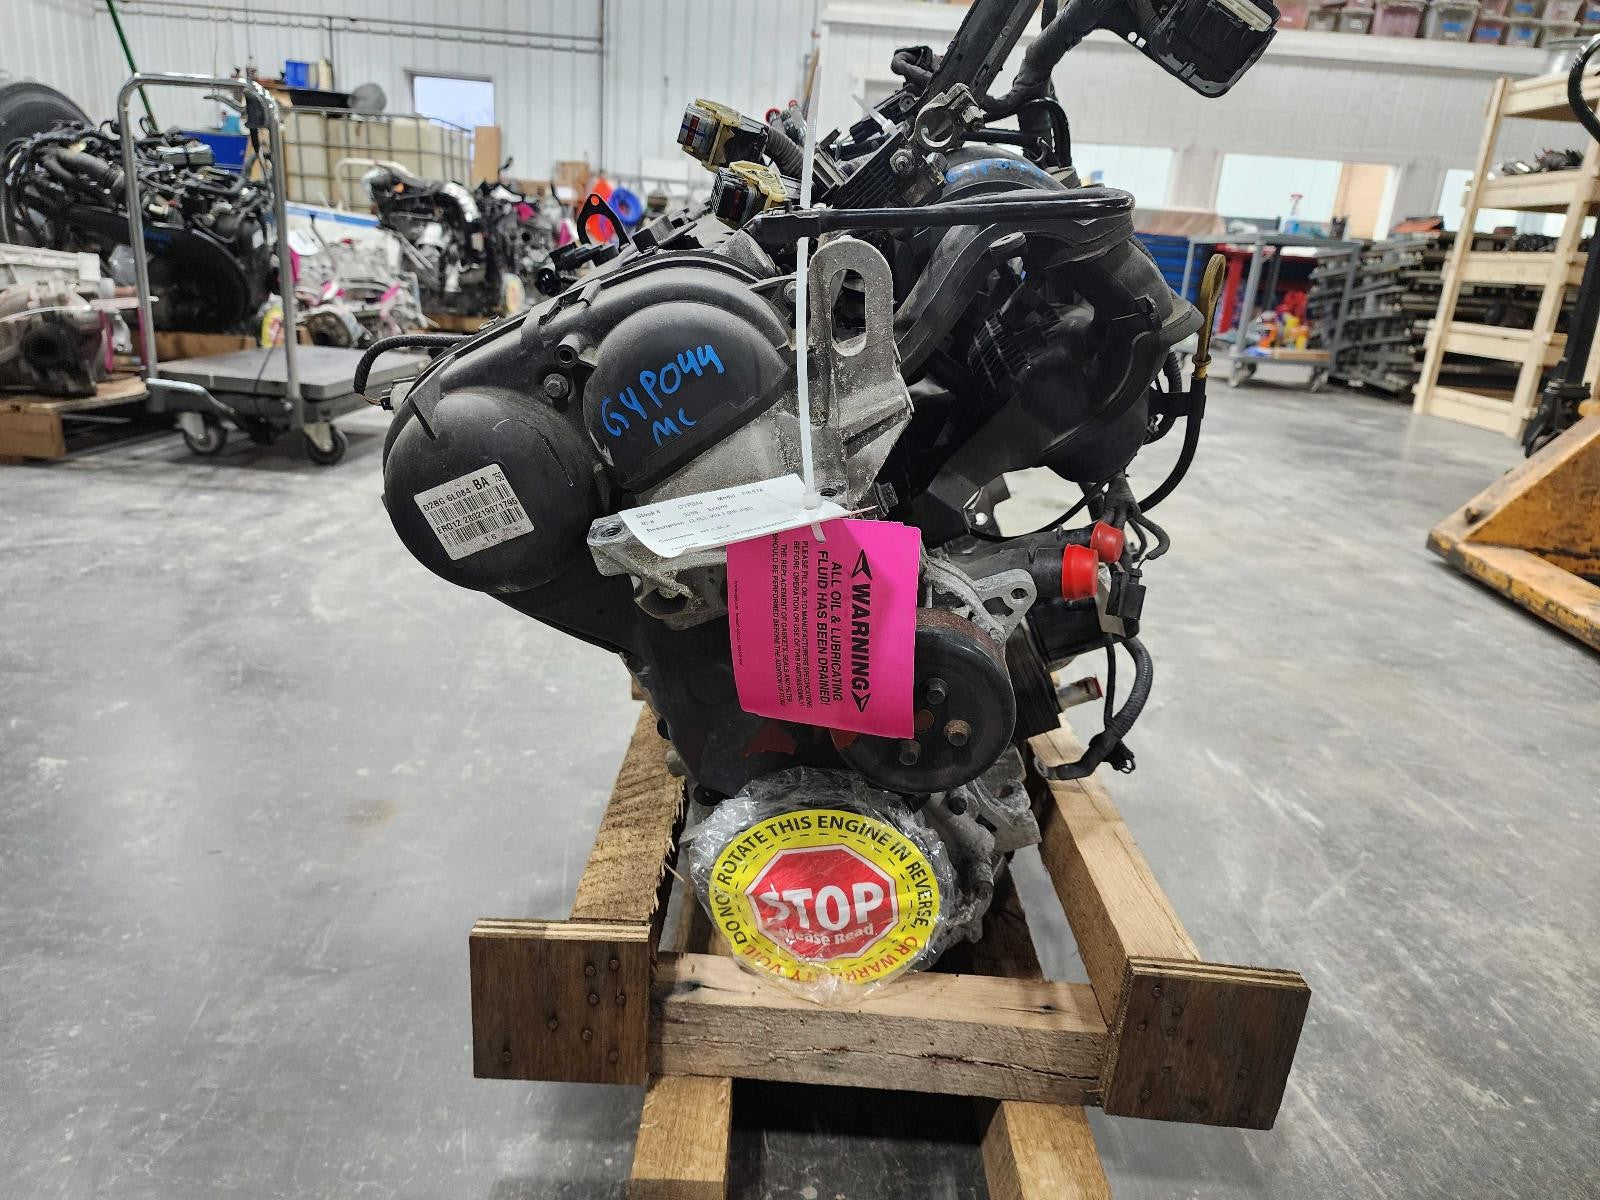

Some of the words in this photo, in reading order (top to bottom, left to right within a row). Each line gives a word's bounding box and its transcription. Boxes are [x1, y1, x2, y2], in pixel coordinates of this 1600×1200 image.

[601, 344, 725, 437] GYP044
[651, 408, 697, 448] MC
[422, 497, 446, 512] D2BG
[446, 487, 472, 502] 6L084
[473, 476, 490, 491] BA
[772, 565, 779, 575] BE
[818, 551, 829, 589] FLUID
[831, 562, 842, 587] ALL
[802, 601, 808, 609] TO
[817, 593, 828, 619] HAS
[831, 591, 842, 611] OIL
[781, 612, 788, 622] OF
[793, 613, 799, 623] OR
[831, 616, 841, 624] &
[794, 639, 800, 648] OF
[817, 623, 828, 655] BEEN
[852, 584, 871, 691] WARNING
[782, 654, 790, 673] SEALS
[831, 628, 843, 701] LUBRICATING
[818, 658, 831, 706] DRAINED!
[765, 816, 812, 837] THIS
[818, 816, 893, 846] ENGINE
[717, 831, 769, 886] ROTATE
[889, 841, 912, 862] IN
[759, 882, 884, 931] STOP
[726, 921, 748, 945] DO
[835, 922, 874, 945] Read
[895, 936, 918, 956] OR
[743, 944, 781, 974] VOID
